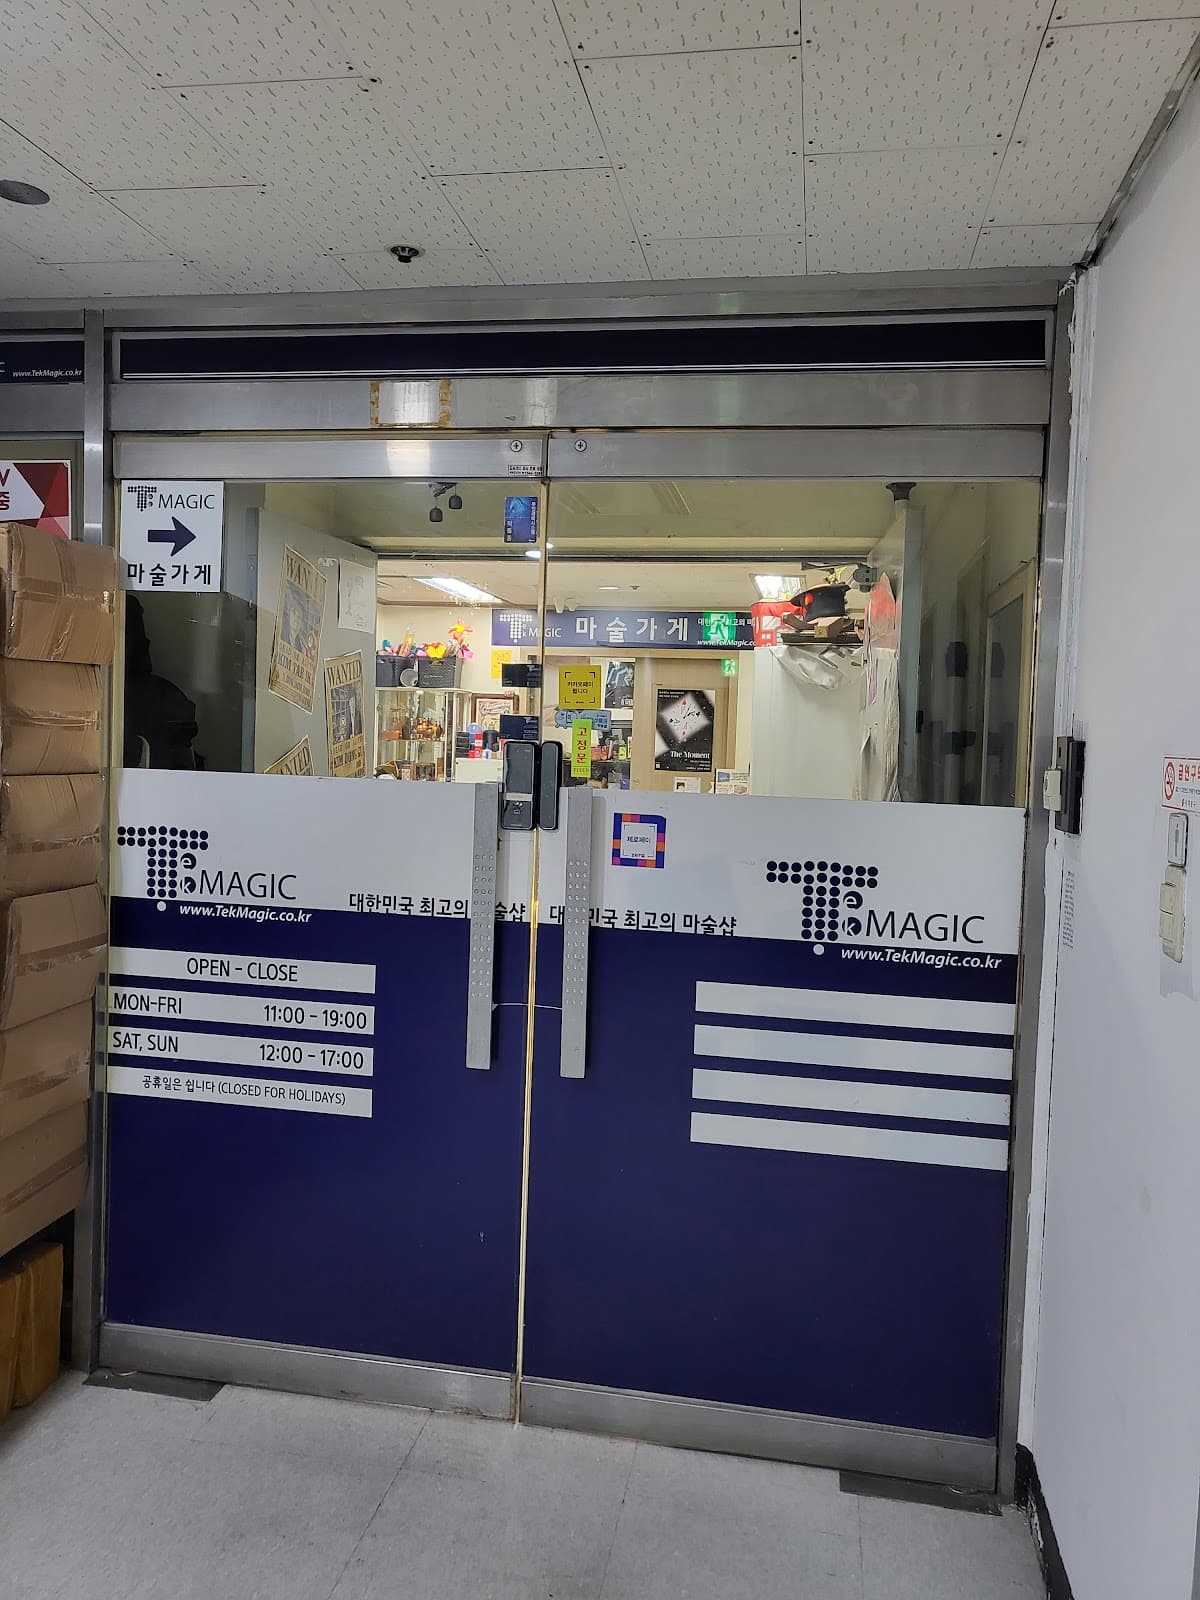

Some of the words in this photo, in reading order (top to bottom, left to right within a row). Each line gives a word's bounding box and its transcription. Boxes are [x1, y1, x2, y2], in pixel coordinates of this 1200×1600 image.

[127, 563, 211, 587] 마술가게
[528, 627, 562, 638] MGIC
[576, 616, 688, 643] 마술가게
[577, 728, 587, 764] 고정문
[670, 750, 682, 759] The
[684, 751, 710, 759] Moment
[179, 904, 312, 923] www.TekMagic.co.kr
[349, 893, 414, 915] 대한민국
[419, 896, 469, 919] 최고의
[549, 905, 618, 929] 대민국
[623, 909, 676, 933] 최고의
[683, 914, 737, 937] 마술샵
[187, 957, 230, 977] OPEN
[247, 962, 298, 982] CLOSE
[841, 949, 1002, 969] www.TekMagic.co.kr
[113, 992, 182, 1015] MON-FRI
[264, 1005, 305, 1024] 11:00
[322, 1009, 367, 1029] 19:00
[112, 1031, 142, 1052] SAT,
[147, 1034, 179, 1053] SUN
[259, 1044, 303, 1064] 12:00
[320, 1049, 364, 1069] 17:00
[142, 1075, 182, 1092] 공휴일은
[185, 1079, 216, 1094] 쉽니다
[218, 1080, 261, 1097] (CLOSED
[264, 1086, 286, 1099] FOR
[288, 1088, 346, 1106] HOLIDAYS)
